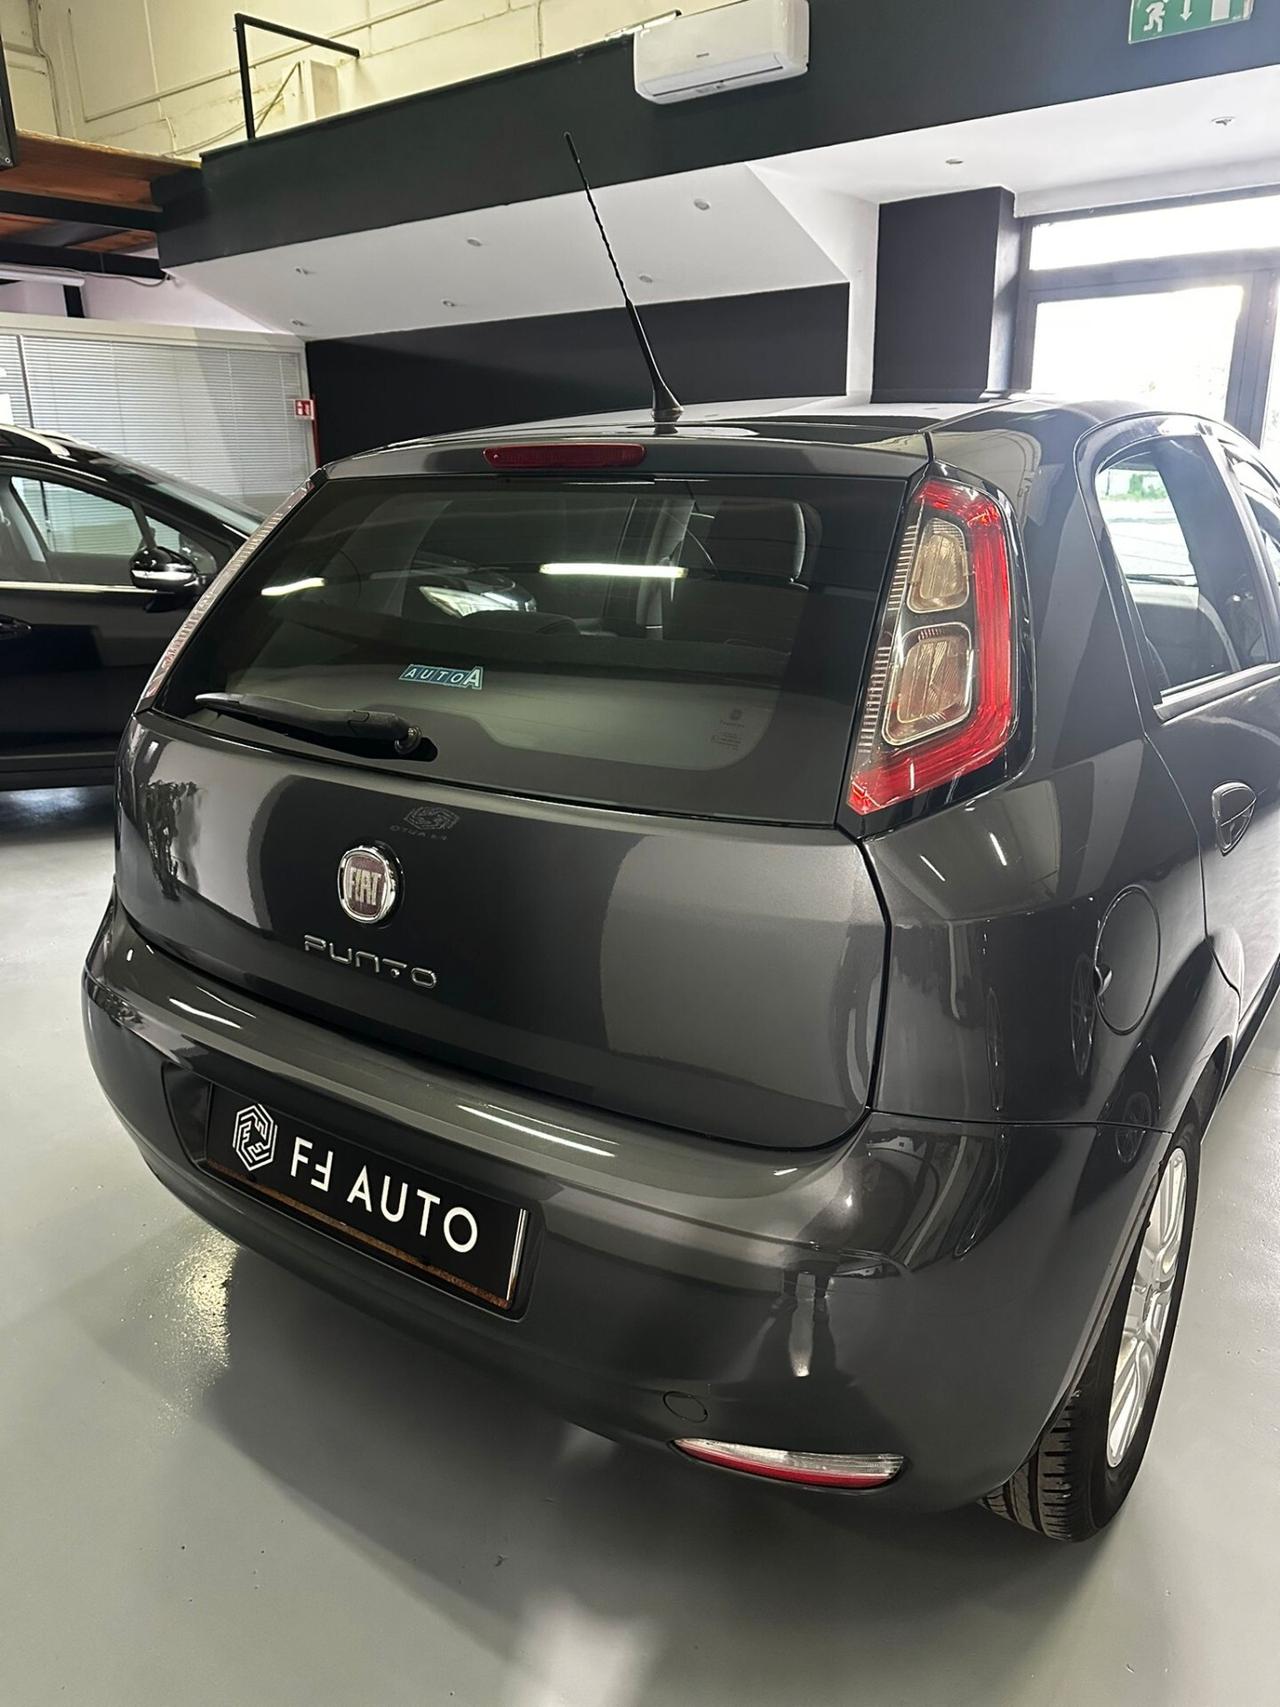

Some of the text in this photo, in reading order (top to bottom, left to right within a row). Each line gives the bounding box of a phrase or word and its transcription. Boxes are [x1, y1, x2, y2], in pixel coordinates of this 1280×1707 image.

[350, 867, 382, 906] FIAT
[304, 934, 437, 989] PUNTO
[346, 1165, 478, 1253] AUTO
